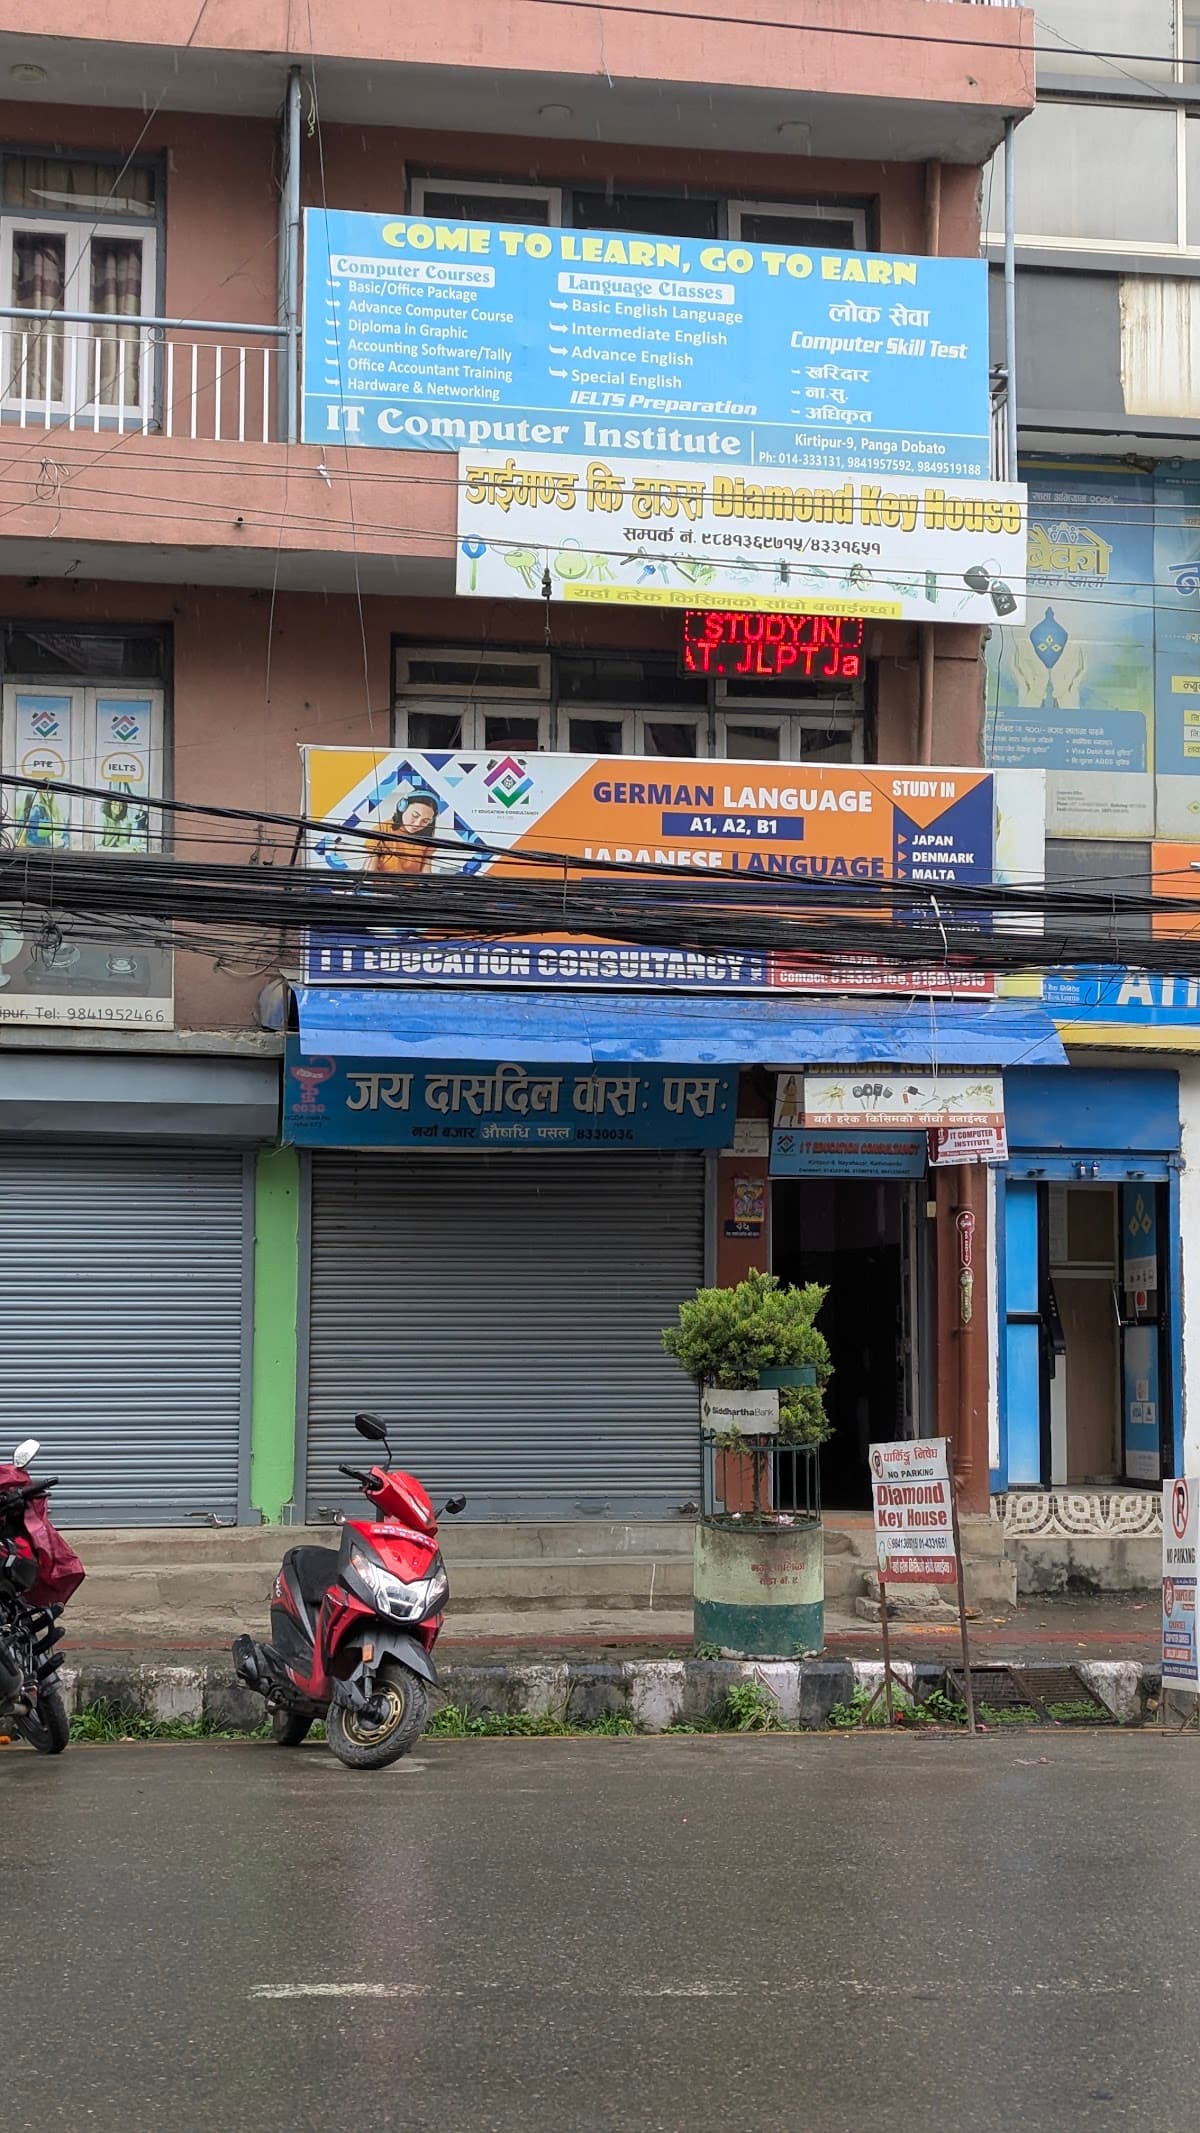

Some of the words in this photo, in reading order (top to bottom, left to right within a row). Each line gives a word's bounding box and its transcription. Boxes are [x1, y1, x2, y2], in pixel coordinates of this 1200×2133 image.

[382, 222, 491, 254] COME
[500, 231, 552, 259] TO
[561, 236, 690, 274] LEARN,
[700, 247, 753, 274] GO
[761, 251, 812, 279] TO
[821, 257, 917, 287] EARN
[337, 257, 420, 280] Computer
[425, 265, 491, 284] Courses
[349, 280, 424, 298] Basic/Office
[427, 285, 478, 303] Package
[568, 274, 654, 298] Language
[658, 282, 724, 300] Classes
[349, 300, 402, 317] Advance
[405, 304, 468, 321] Computer
[471, 308, 514, 323] Course
[572, 300, 610, 315] Basic
[615, 302, 668, 320] English
[672, 307, 743, 325] Language
[829, 299, 882, 324] लोक
[889, 303, 930, 328] सेवा
[349, 319, 401, 337] Diploma
[404, 323, 417, 336] in
[420, 324, 468, 341] Graphic
[572, 324, 670, 342] Intermediate
[674, 331, 728, 347] English
[348, 339, 418, 358] Accounting
[421, 343, 512, 364] Software/Tally
[791, 330, 883, 354] Computer
[886, 337, 925, 357] Skill
[930, 340, 968, 360] Test
[572, 346, 636, 362] Advance
[641, 351, 693, 367] English
[348, 358, 385, 373] Office
[388, 361, 459, 377] Accountant
[463, 365, 513, 383] Training
[572, 369, 626, 386] Special
[629, 372, 682, 390] English
[805, 364, 872, 383] खरिदार
[348, 377, 409, 394] Hardware
[413, 381, 424, 393] &
[427, 382, 500, 401] Networking
[570, 390, 625, 407] IELTS
[630, 394, 757, 416] Preparation
[805, 404, 873, 425] अधिकृत
[326, 405, 365, 431] IT
[377, 408, 570, 444] Computer
[583, 420, 741, 455] Institute
[795, 433, 858, 451] Kirtipur-9,
[861, 438, 898, 455] Panga
[901, 440, 946, 455] Dobato
[759, 451, 777, 464] Ph:
[779, 453, 843, 469] 014-333131,
[847, 456, 914, 473] 9841957592,
[917, 461, 981, 476] 9849519188
[586, 461, 626, 512] कि
[631, 476, 706, 521] हाउस
[713, 475, 854, 525] Diamond
[861, 484, 919, 532] Key
[924, 488, 1022, 534] House
[622, 526, 675, 544] सम्पर्क
[616, 589, 663, 603] हरेक
[669, 592, 756, 608] किसिमको
[705, 614, 806, 643] STUDY
[813, 617, 841, 644] IN
[737, 644, 819, 675] JLPT
[824, 648, 860, 677] Ja
[33, 760, 53, 768] PTE
[108, 764, 136, 772] IELTS
[593, 781, 714, 807] GERMAN
[723, 786, 873, 814] LANGUAGE
[892, 780, 936, 798] STUDY
[939, 782, 956, 798] IN
[689, 817, 718, 836] A1,
[722, 817, 752, 837] A2,
[757, 819, 777, 836] B1
[912, 834, 954, 847] JAPAN
[732, 851, 885, 880] LANGUAGE
[912, 851, 974, 864] DENMARK
[912, 869, 956, 881] MALTA
[364, 947, 530, 976] EDUCATION
[537, 948, 745, 980] CONSULTANCY
[780, 970, 828, 984] Contact:
[35, 1007, 61, 1020] Tel:
[67, 1007, 165, 1023] 9841952466
[345, 1072, 414, 1111] जय
[837, 1112, 861, 1124] हरेक
[866, 1112, 913, 1125] किसिमको
[537, 1126, 572, 1139] पसल
[954, 1139, 990, 1148] INSTITUTE
[957, 1129, 993, 1140] COMPUTER
[888, 1471, 899, 1479] NO
[901, 1468, 934, 1478] PARKING
[877, 1482, 945, 1506] Diamond
[878, 1509, 903, 1529] Key
[908, 1509, 947, 1527] House
[1174, 1548, 1196, 1564] PARKING
